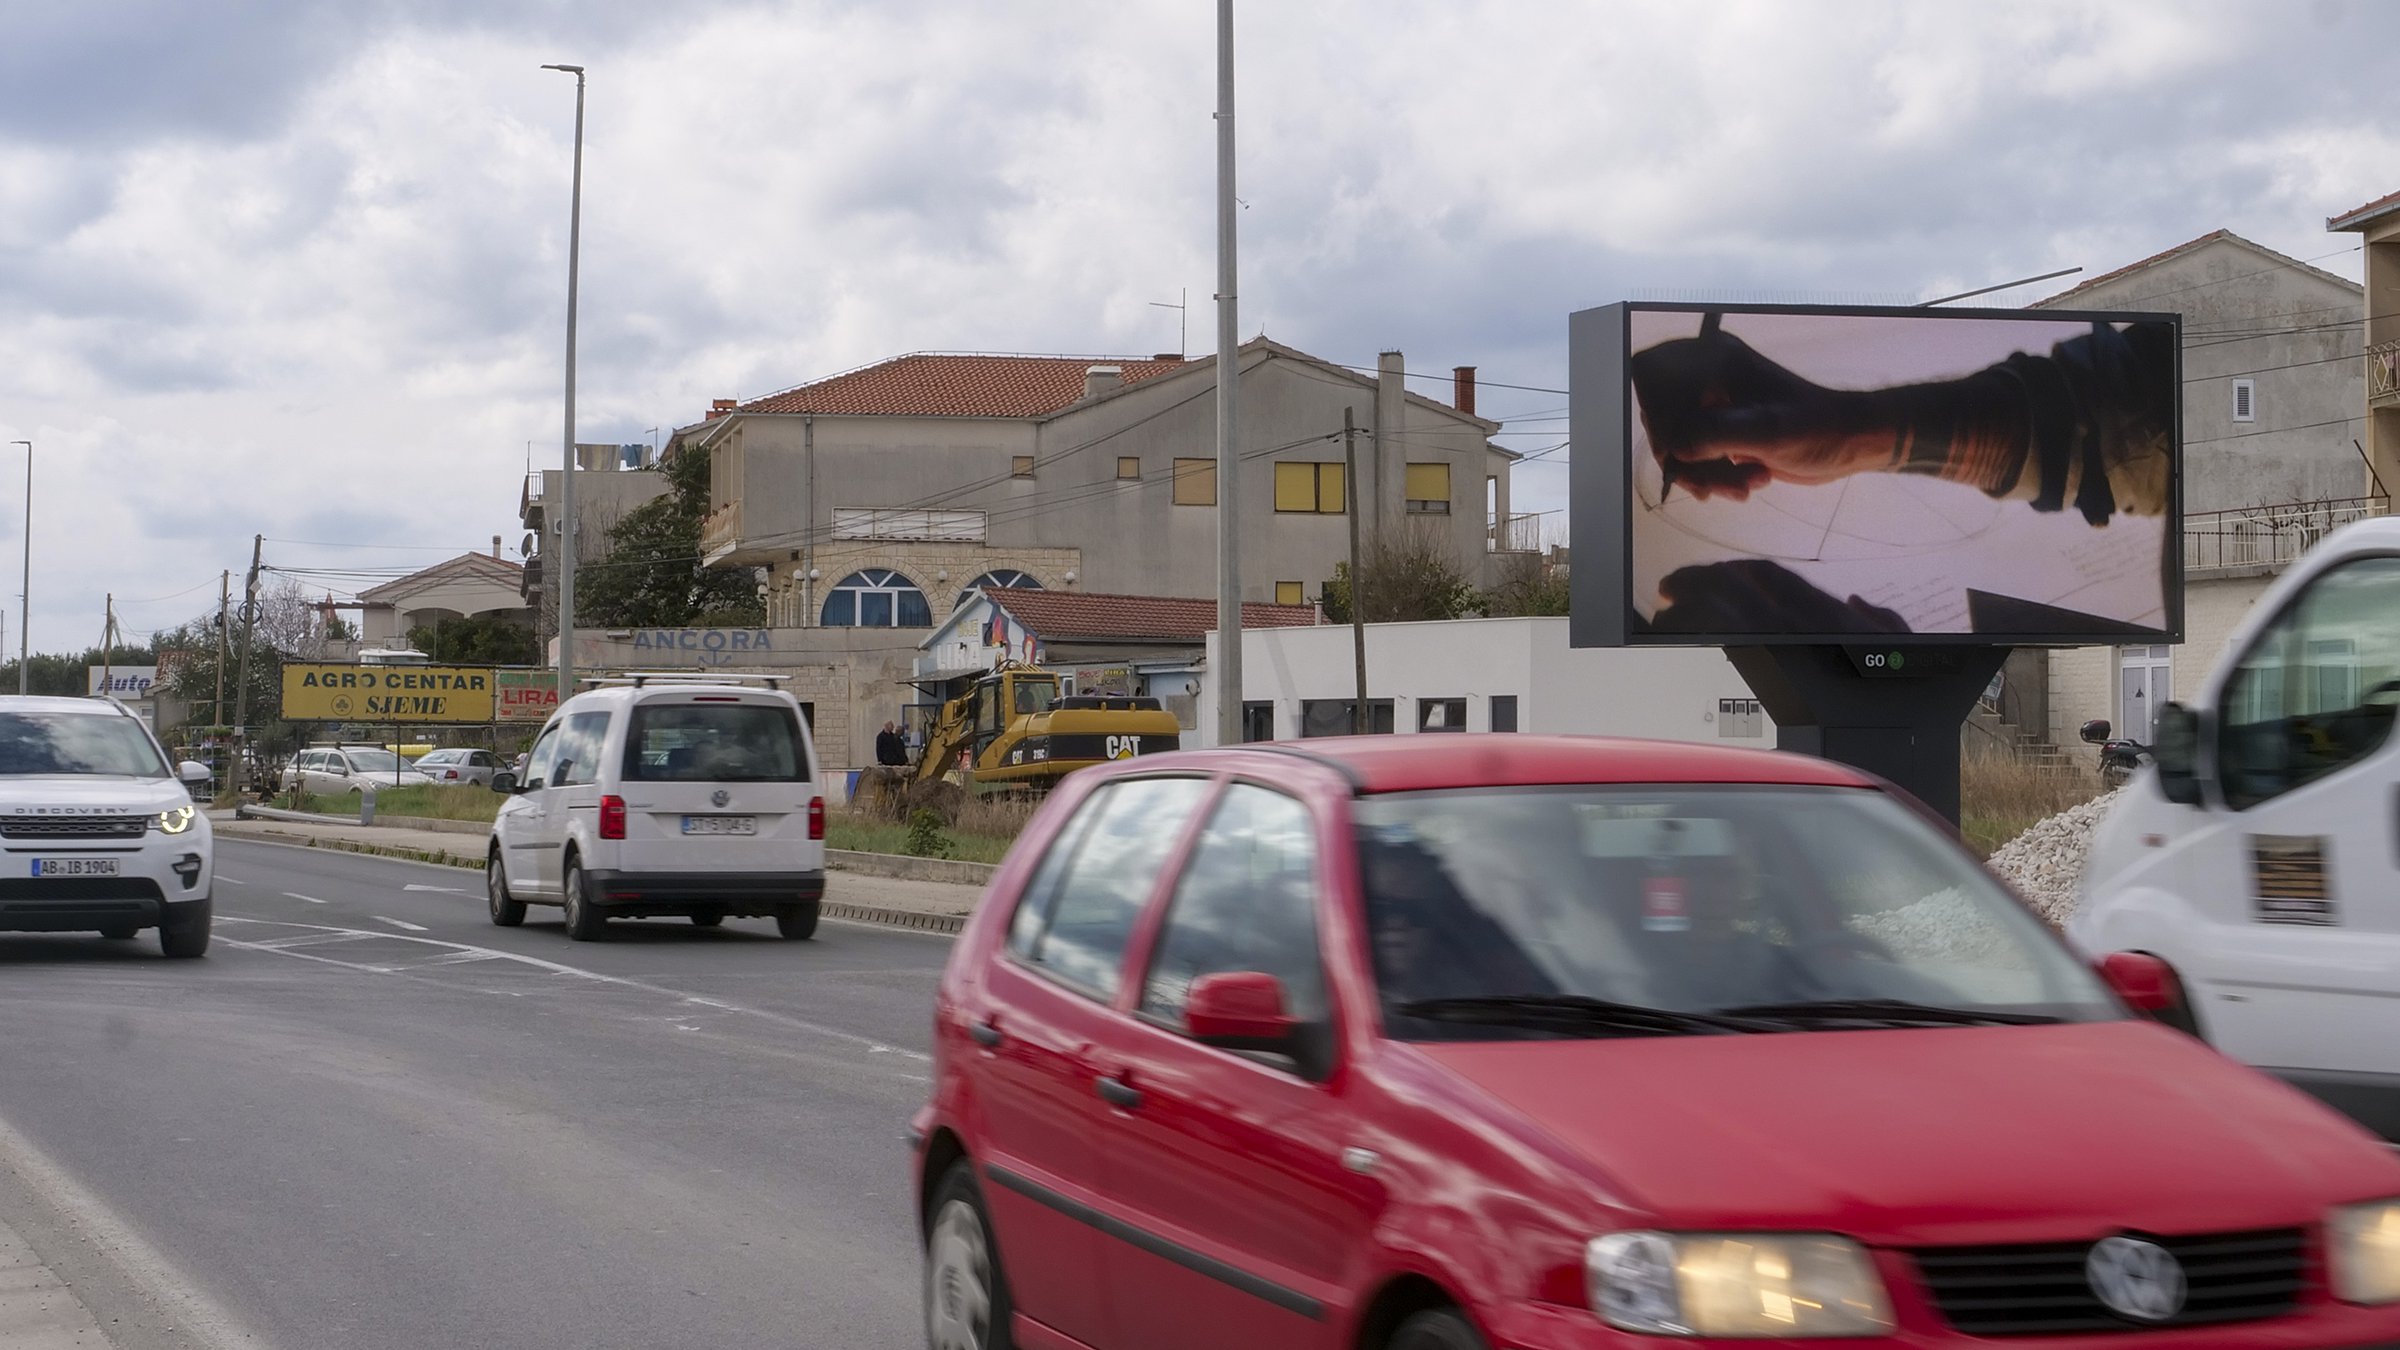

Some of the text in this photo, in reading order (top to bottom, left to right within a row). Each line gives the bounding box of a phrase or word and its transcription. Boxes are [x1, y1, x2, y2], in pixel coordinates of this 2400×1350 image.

[633, 630, 772, 651] ANCORA
[1865, 654, 1885, 667] GO
[97, 674, 151, 692] Auto
[303, 672, 376, 688] AGRO
[385, 674, 485, 690] CENTAR
[365, 696, 447, 714] SJEME
[503, 690, 559, 704] LIRA
[1106, 735, 1141, 760] CAT
[1012, 750, 1023, 765] CAT
[42, 860, 115, 874] AB IB 1904
